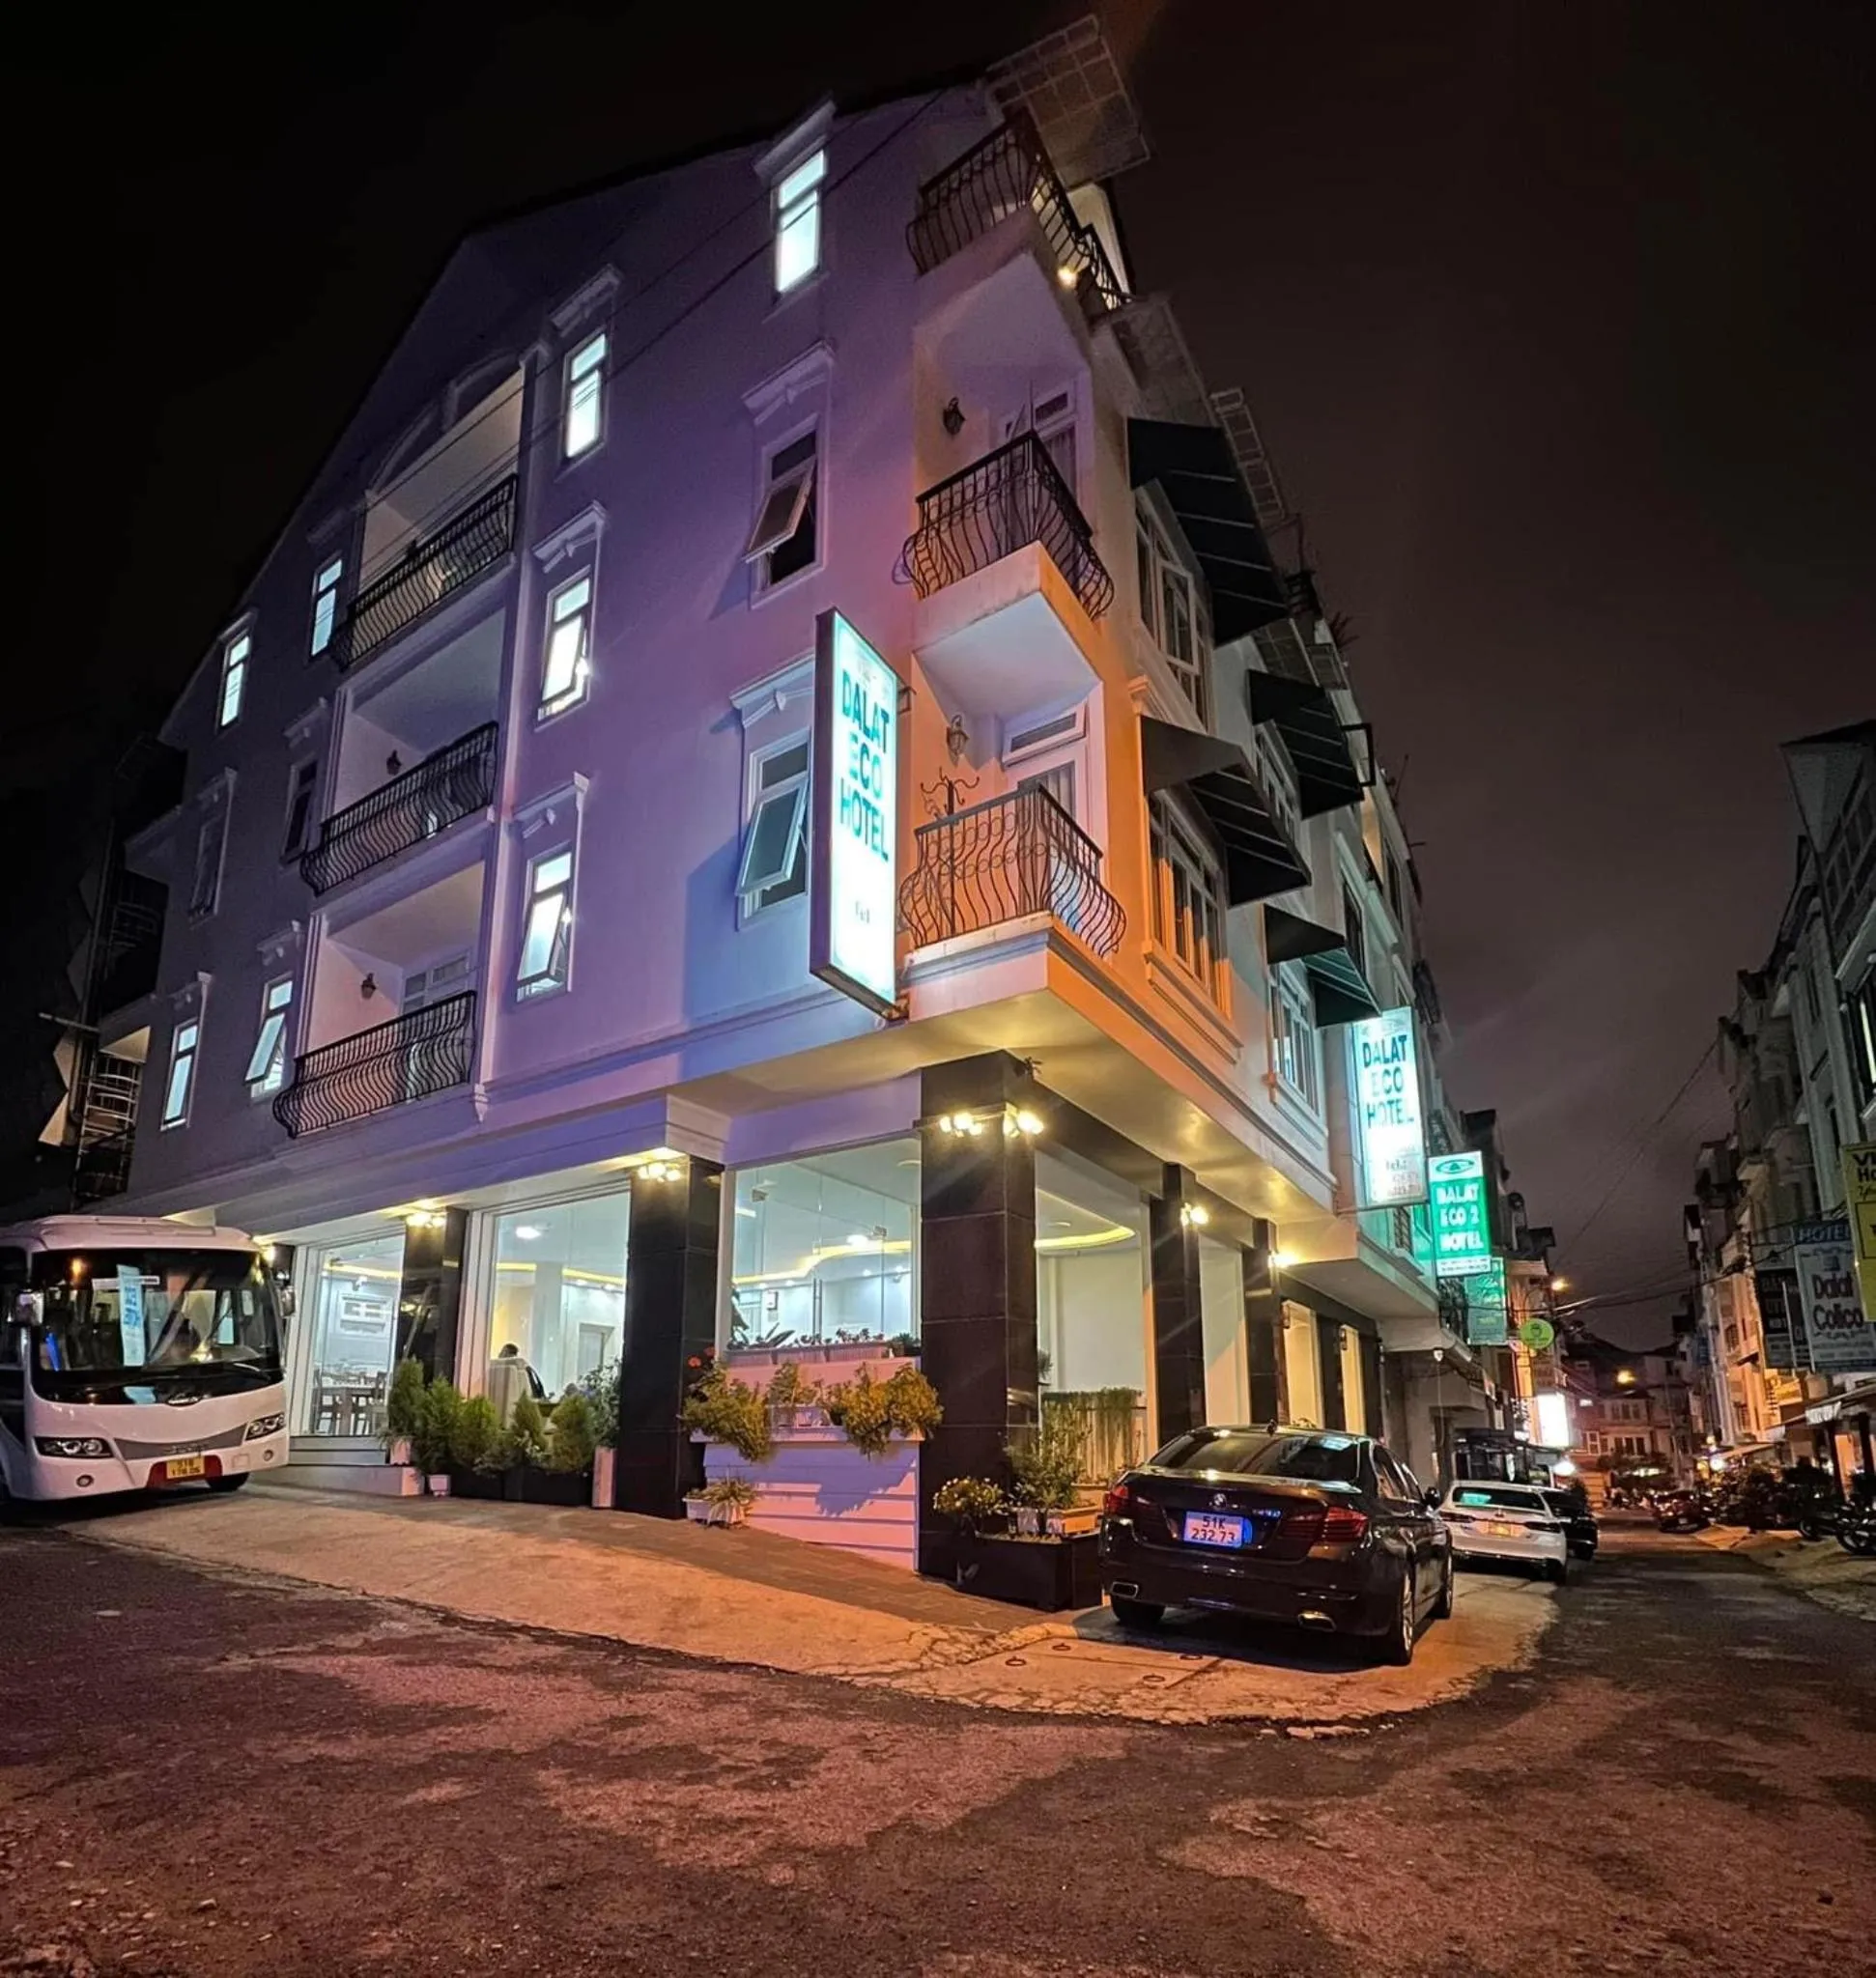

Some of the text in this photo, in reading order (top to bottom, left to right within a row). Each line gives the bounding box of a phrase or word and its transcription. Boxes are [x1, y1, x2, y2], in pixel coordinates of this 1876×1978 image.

[841, 667, 890, 754] DALAT
[848, 730, 883, 801] ECO
[839, 777, 889, 863] HOTEL
[1362, 1034, 1407, 1068] DALAT
[1371, 1066, 1404, 1097] ECO
[1366, 1098, 1415, 1129] HOTEL
[1436, 1182, 1480, 1205] DALAT
[1439, 1203, 1480, 1229] ECO 2
[1439, 1229, 1485, 1253] HOTEL
[1202, 1514, 1226, 1530] 51K
